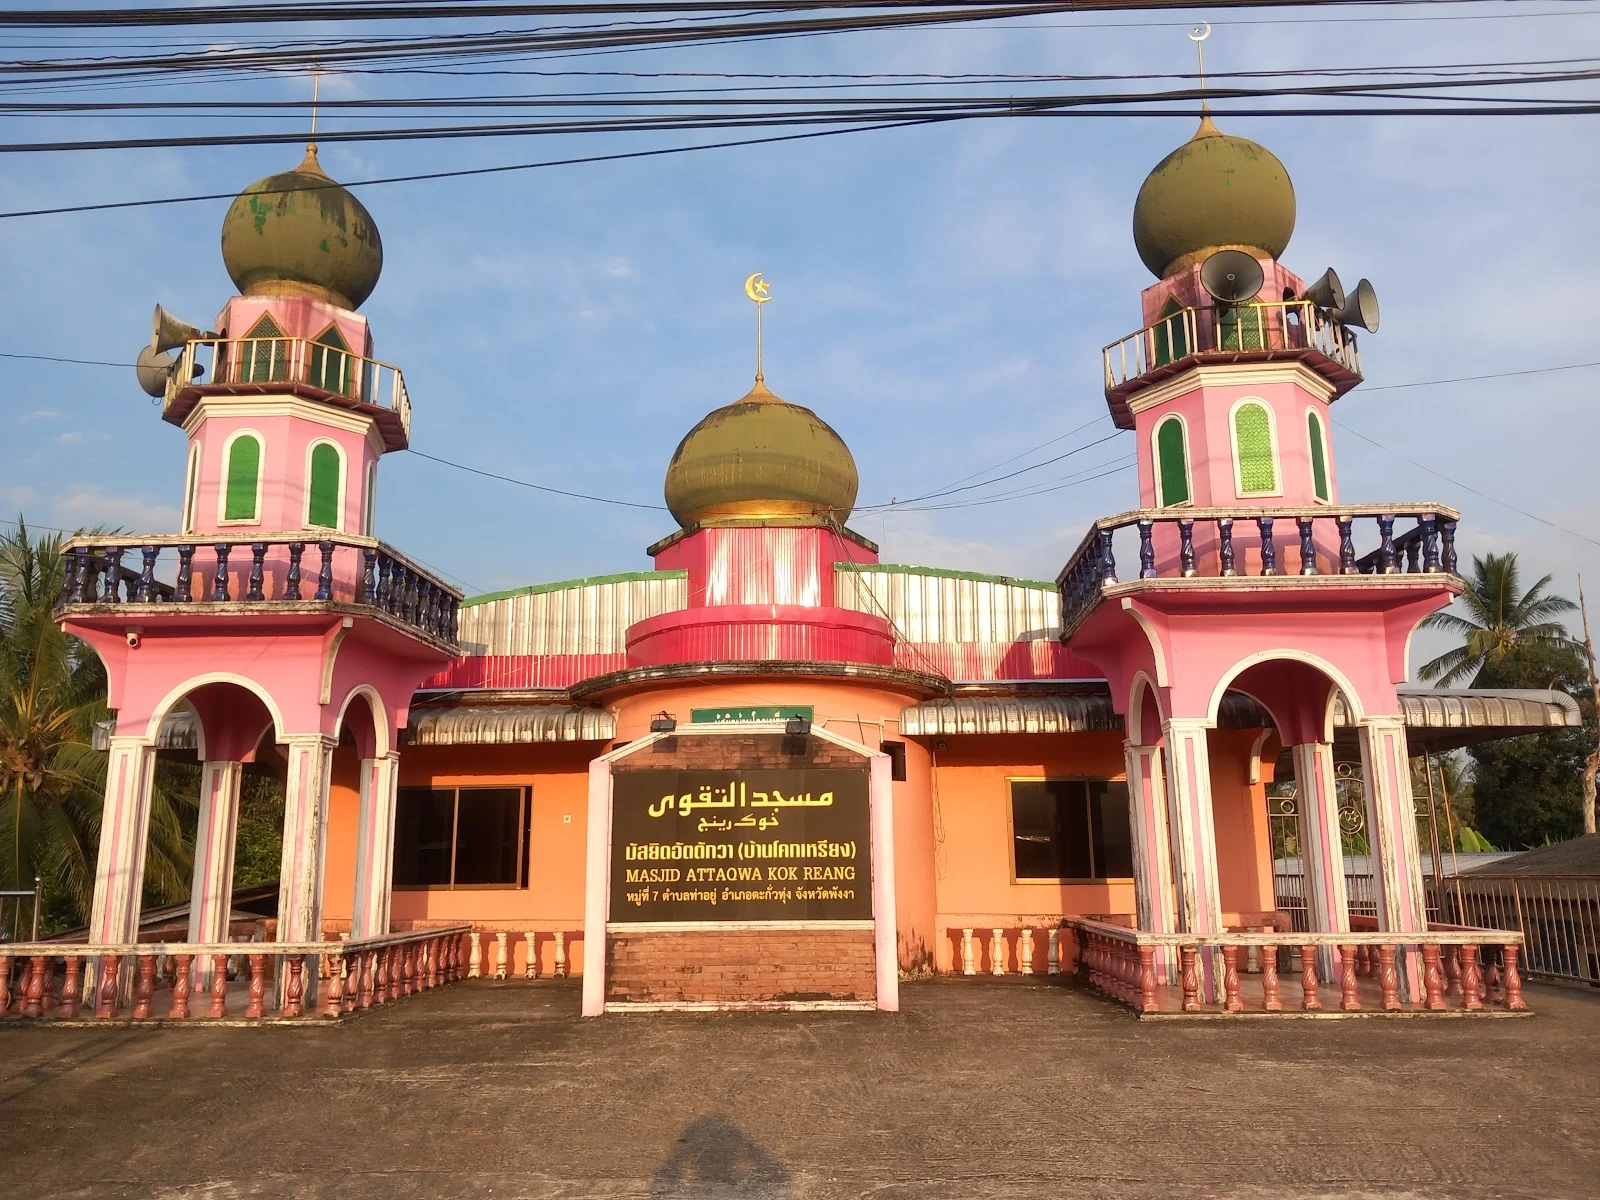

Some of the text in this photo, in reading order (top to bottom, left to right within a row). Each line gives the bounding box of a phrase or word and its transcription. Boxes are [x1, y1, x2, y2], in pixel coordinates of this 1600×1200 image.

[625, 839, 857, 860] มัสยิดอัตตักวา (บ้านโคกเหรียง)
[625, 866, 856, 883] MASJID ATTAQWA KOK REANG
[626, 884, 855, 906] หมู่ที่ 7 ตำบลท่าอยู่ อำเภอตะกั่วทุ่ง จังหวัดพังงา
